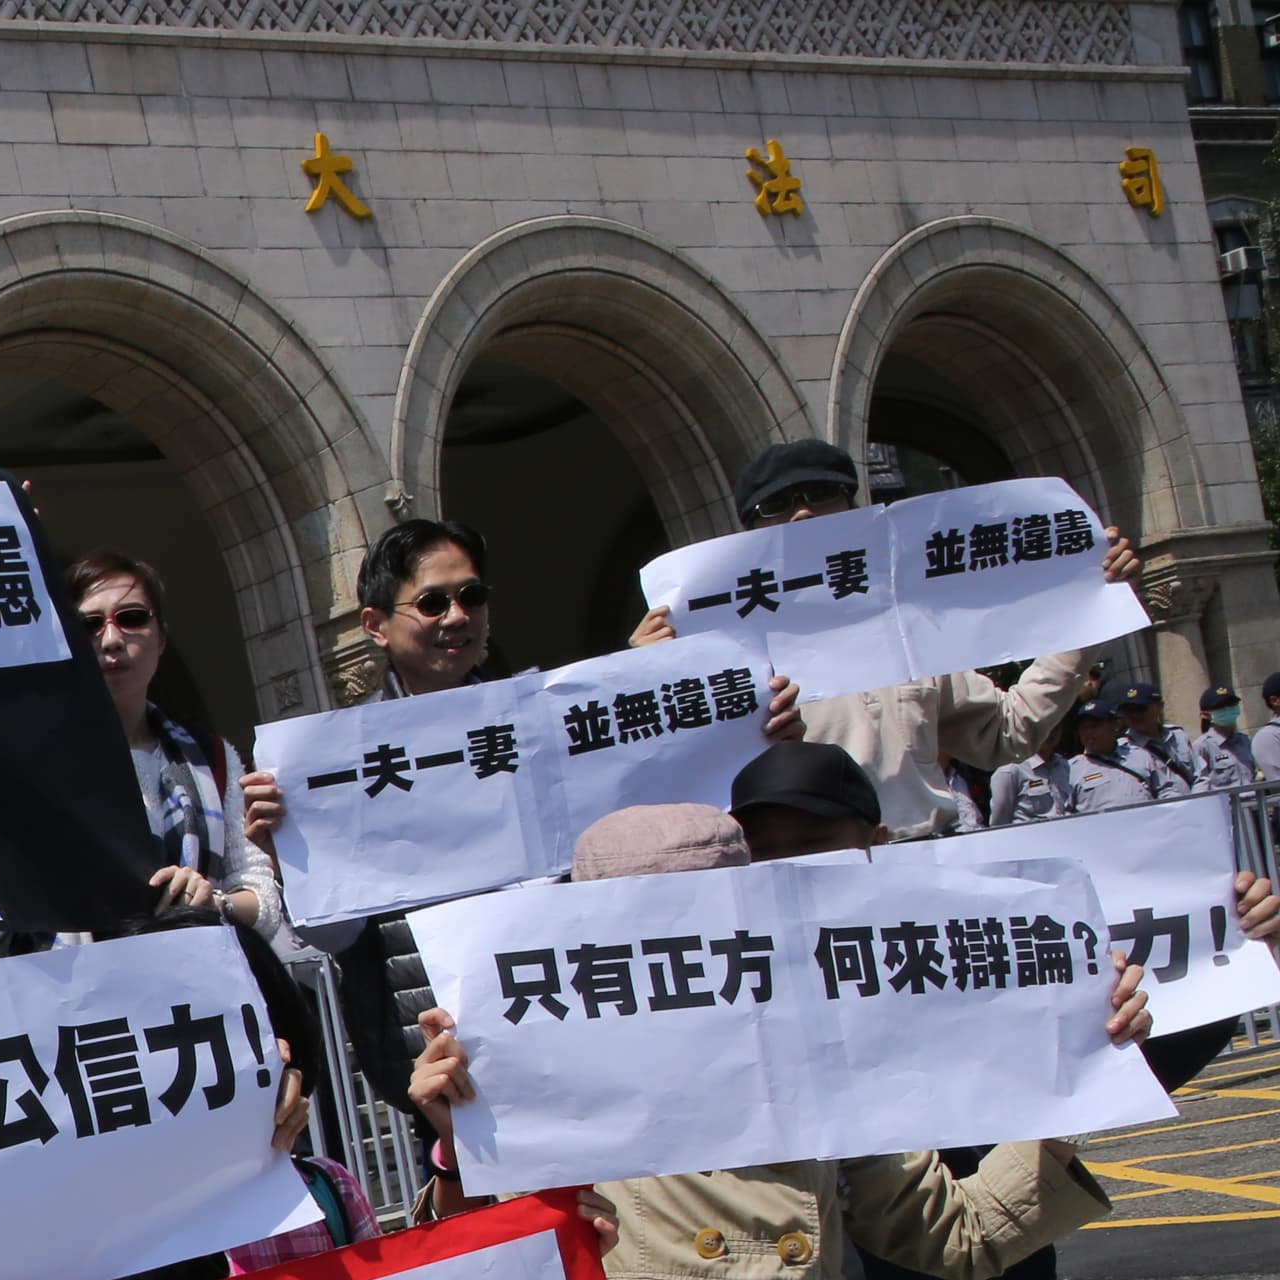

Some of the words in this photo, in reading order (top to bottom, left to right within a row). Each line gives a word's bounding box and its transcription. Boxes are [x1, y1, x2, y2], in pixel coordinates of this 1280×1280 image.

[688, 550, 870, 619] 一夫一妻
[926, 509, 1095, 579] 並無違憲
[307, 724, 518, 799] 一夫一妻
[564, 668, 759, 756] 並無違憲
[495, 930, 774, 1025] 只有正方
[814, 914, 1099, 999] 何來辯論?
